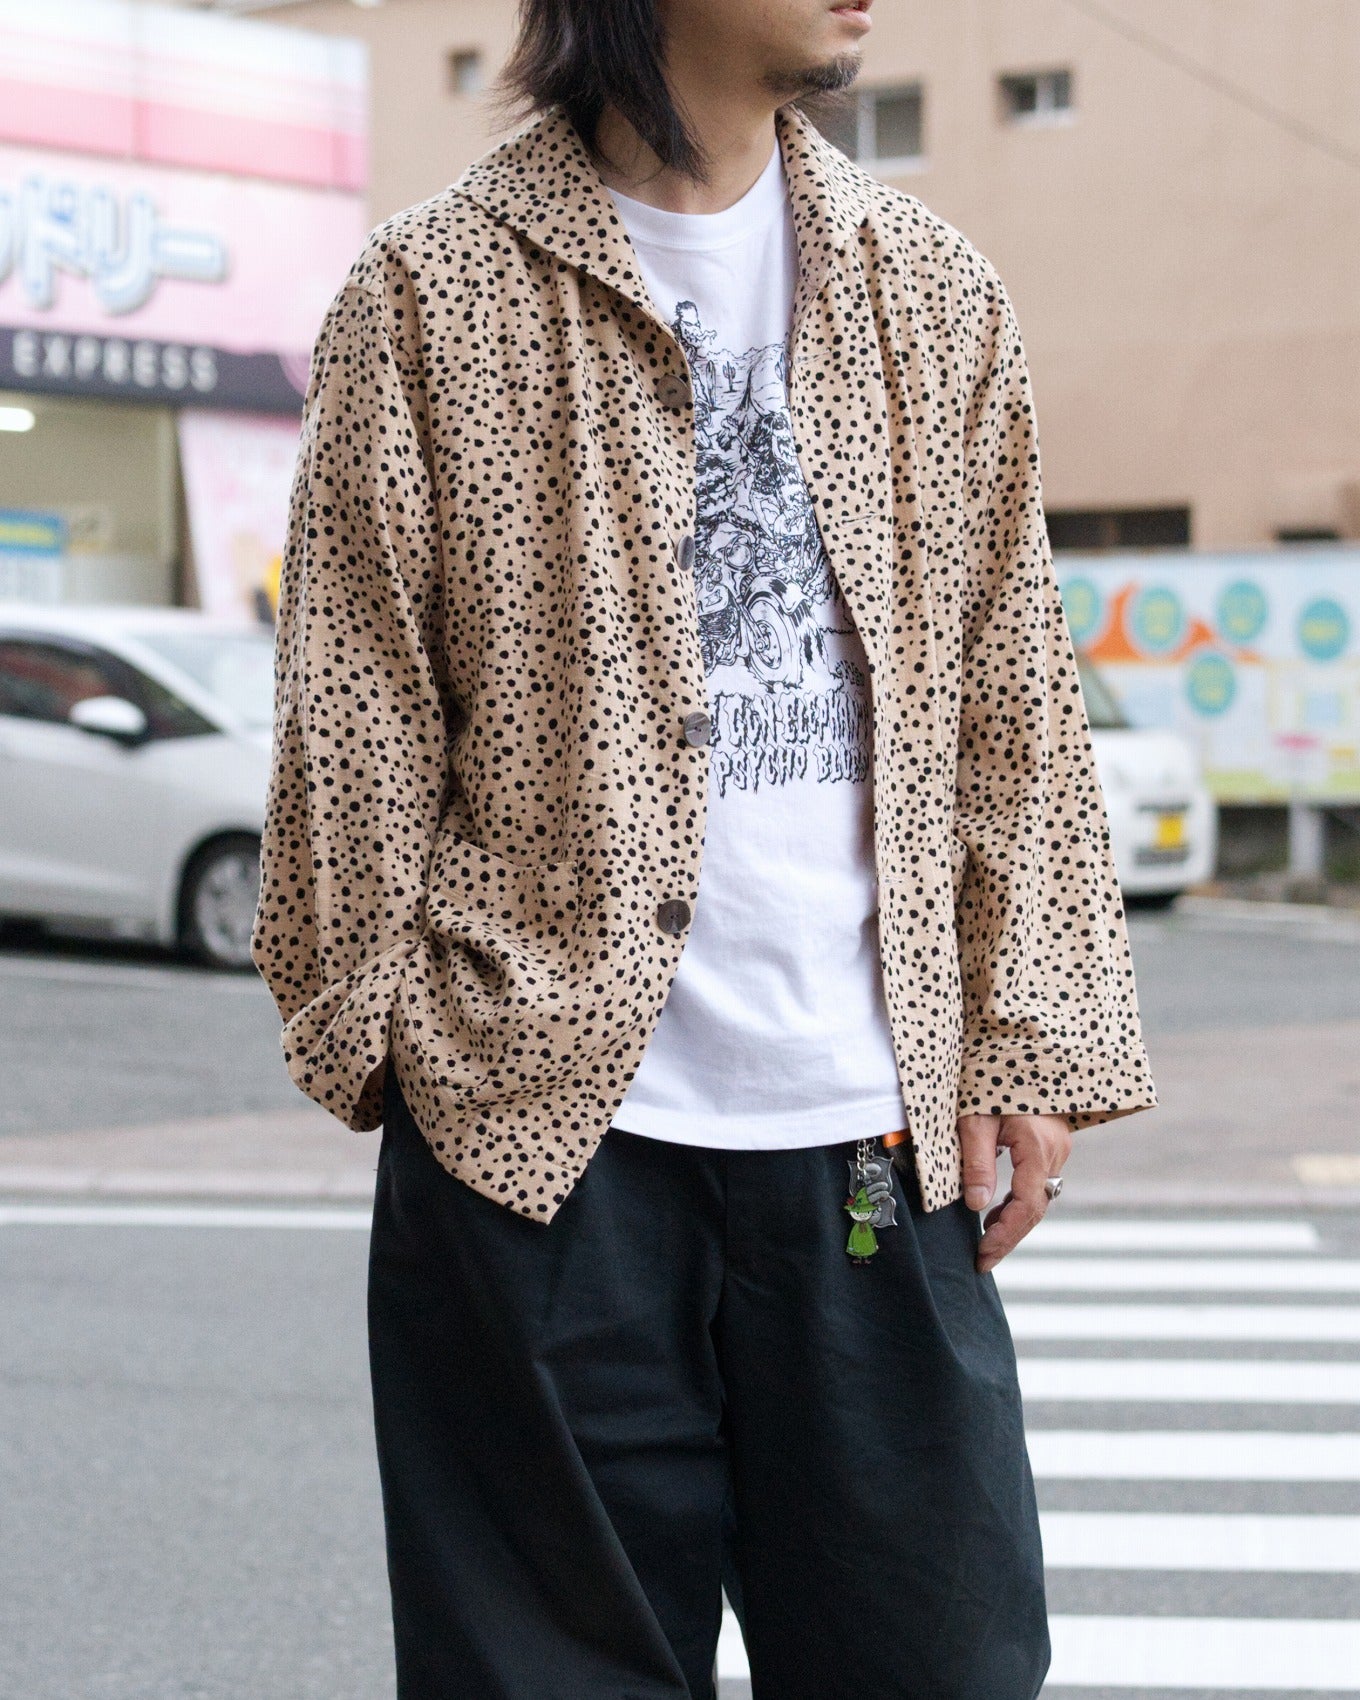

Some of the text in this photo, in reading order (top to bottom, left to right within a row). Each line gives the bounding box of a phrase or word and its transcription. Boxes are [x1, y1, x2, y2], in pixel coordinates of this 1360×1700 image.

[0, 174, 228, 316] ドリー
[12, 331, 217, 391] EXPRESS
[711, 743, 871, 799] PSYCHO BLUES
